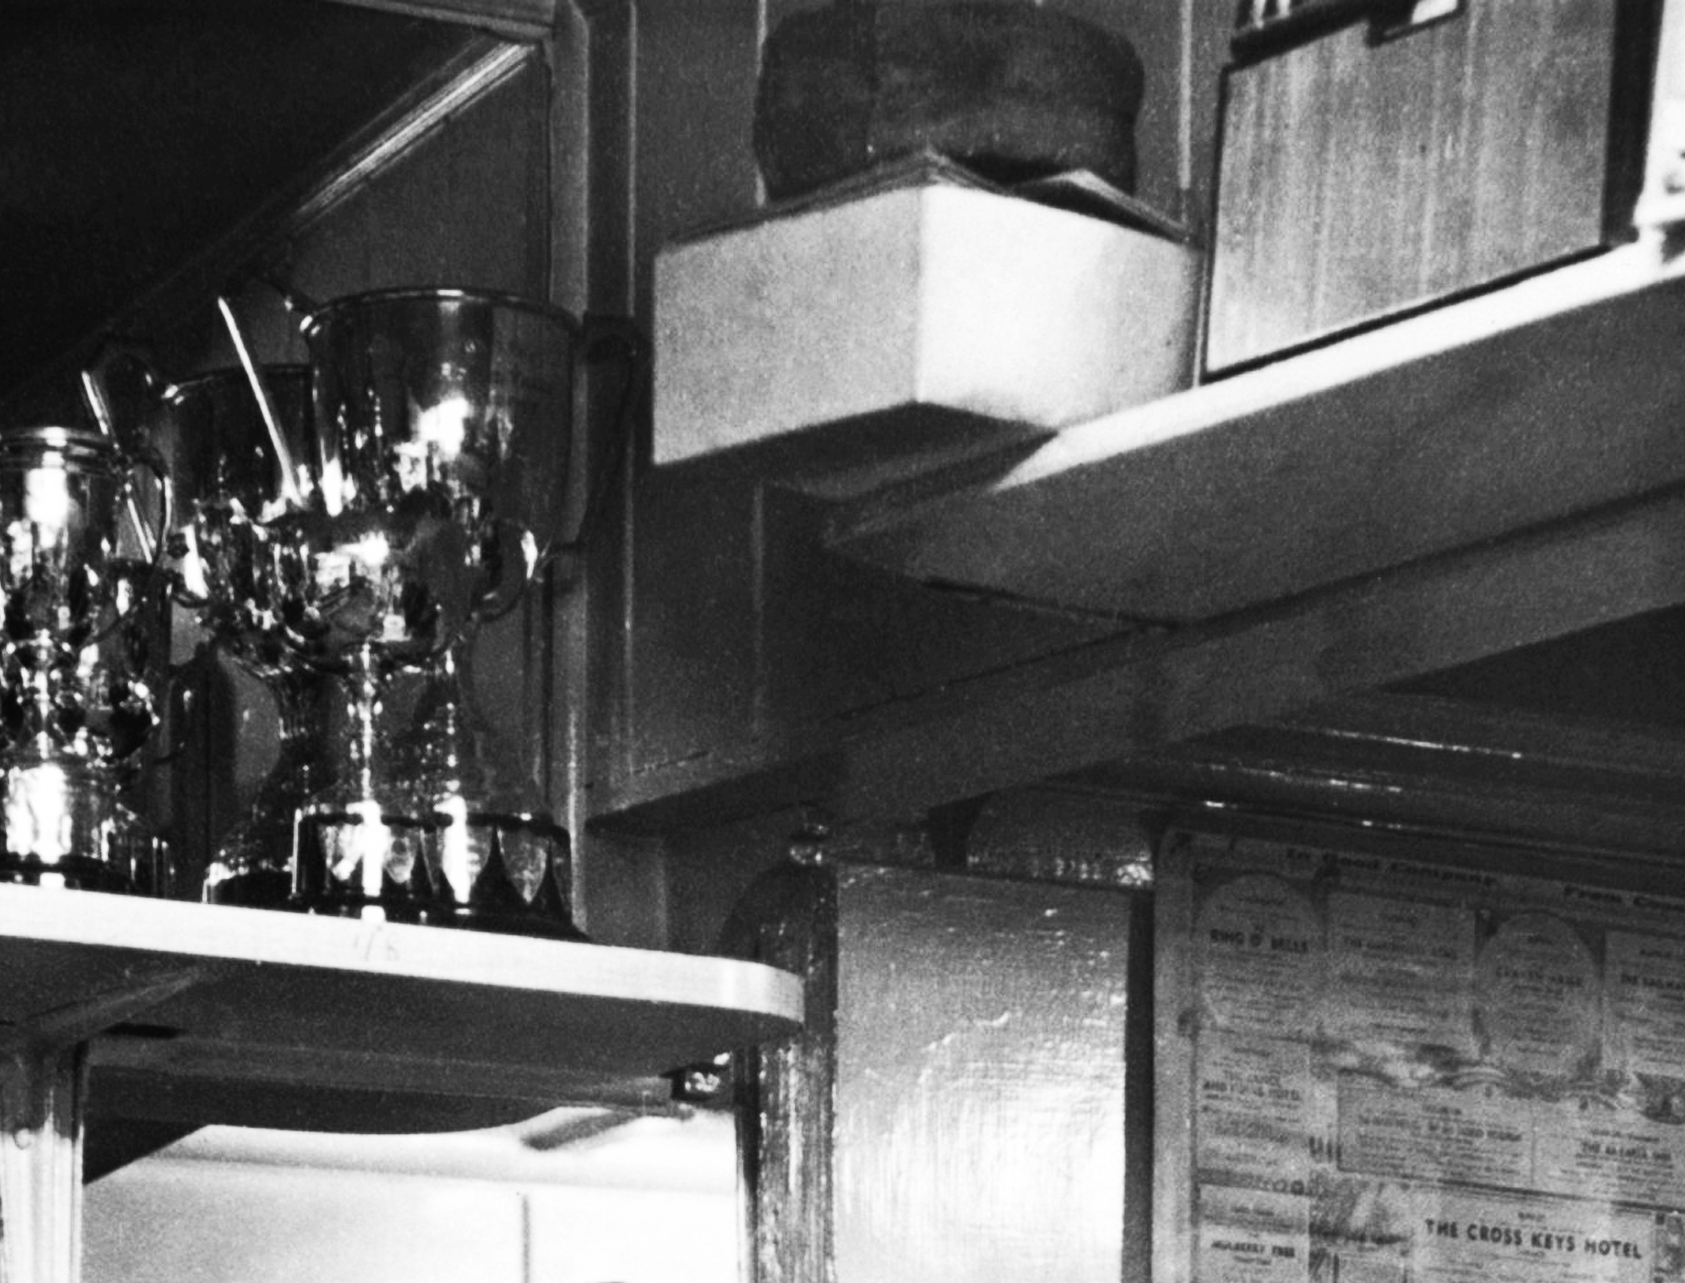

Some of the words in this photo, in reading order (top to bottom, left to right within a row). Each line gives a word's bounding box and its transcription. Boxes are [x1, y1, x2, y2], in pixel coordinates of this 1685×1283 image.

[1425, 1218, 1458, 1241] THE
[1465, 1222, 1525, 1250] CROSS
[1529, 1230, 1576, 1255] KEYS
[1582, 1236, 1643, 1261] HOTEL
